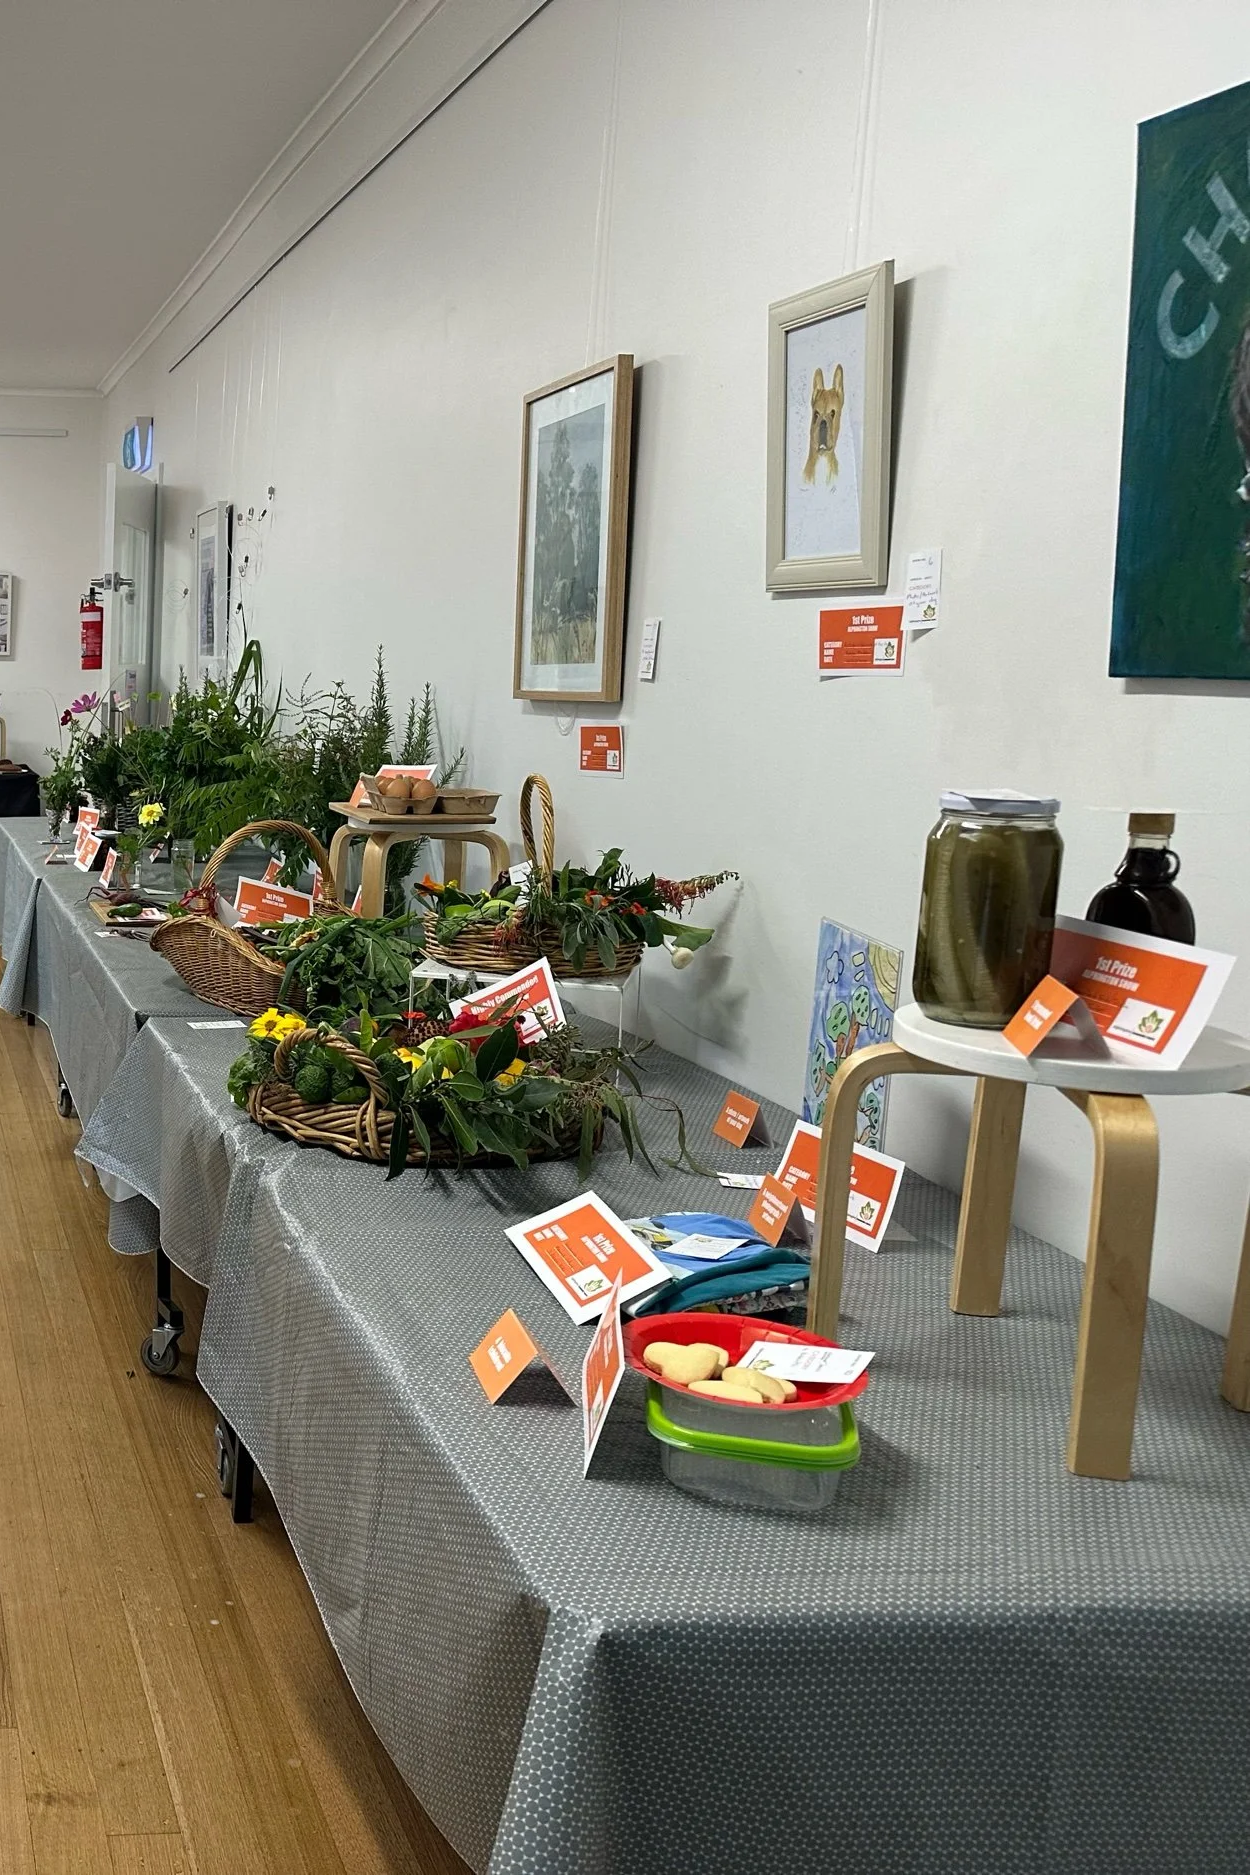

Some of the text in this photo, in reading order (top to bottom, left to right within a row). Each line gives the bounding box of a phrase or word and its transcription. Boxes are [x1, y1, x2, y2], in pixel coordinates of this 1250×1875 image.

[1157, 150, 1250, 361] CH
[852, 614, 875, 625] 1st Prize
[1095, 956, 1138, 980] 1st Prize
[1082, 969, 1141, 993] ALPHINGTON SHOW
[788, 1165, 811, 1181] CATEGORY
[592, 1232, 616, 1256] 1st Prize
